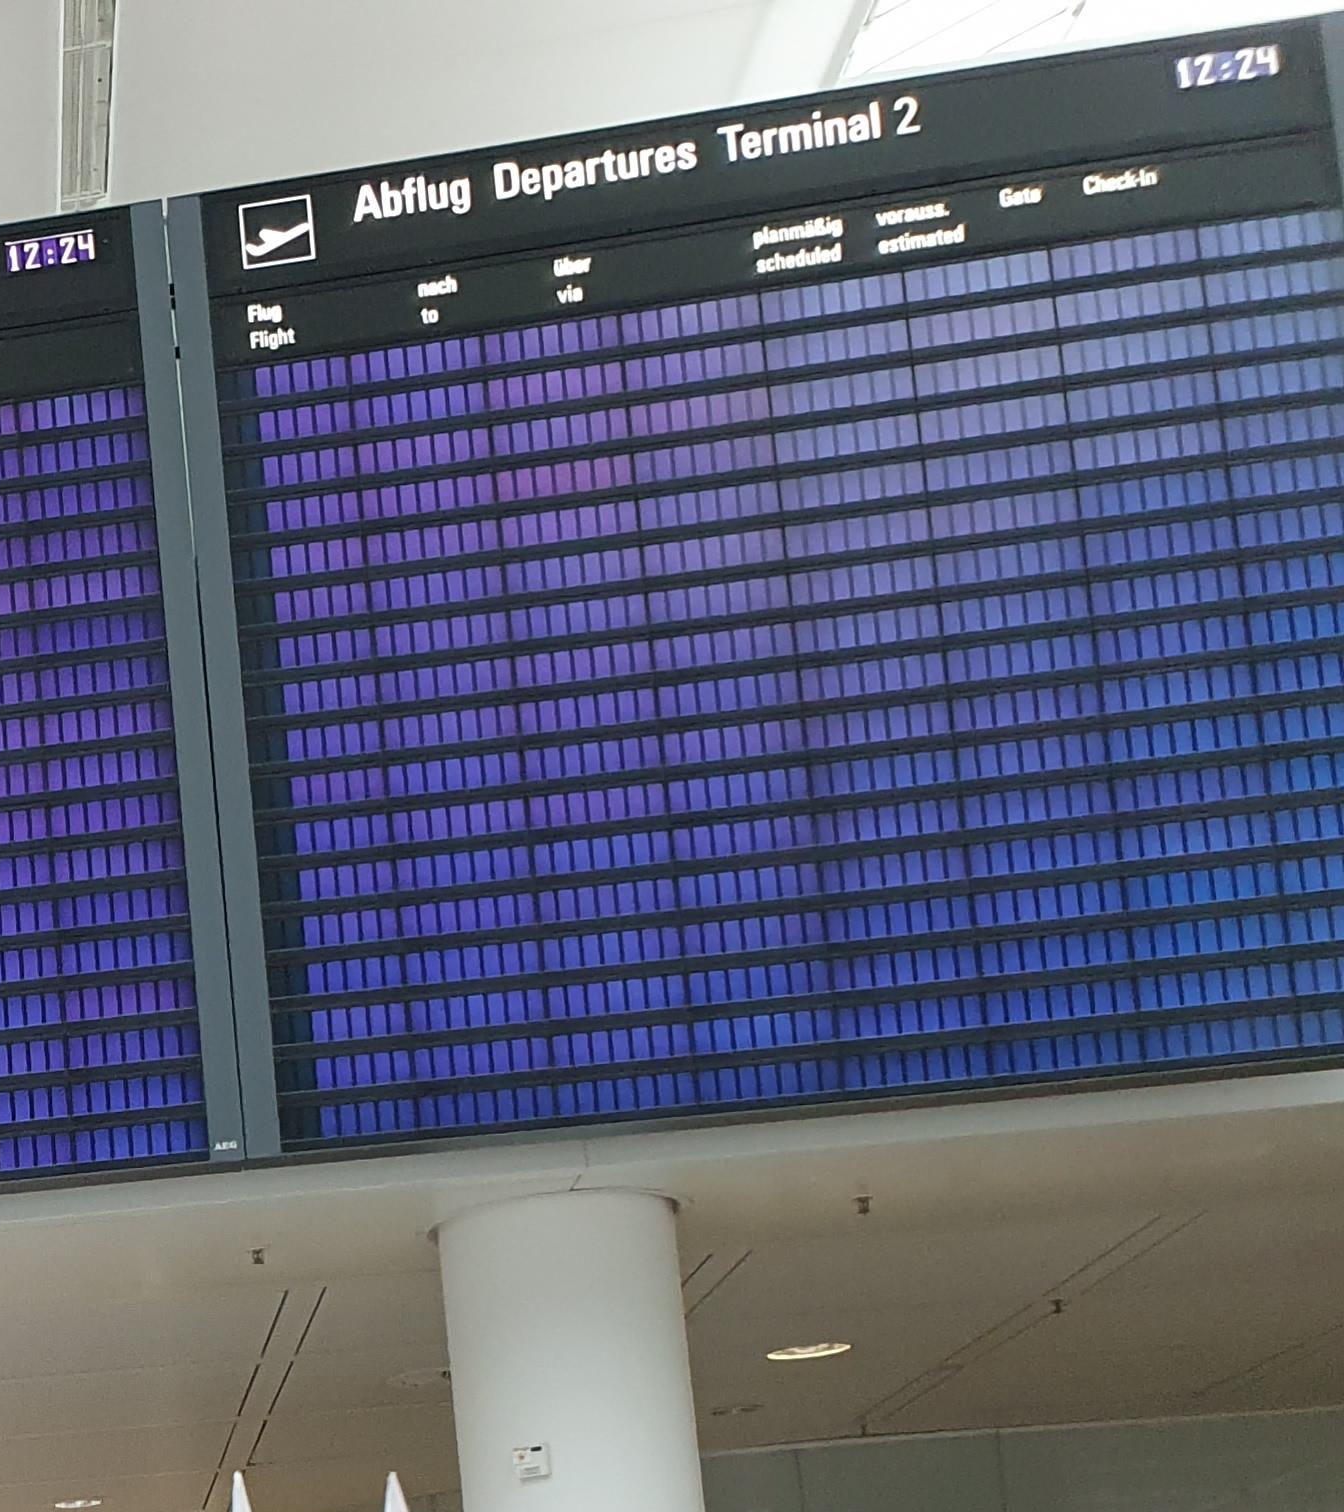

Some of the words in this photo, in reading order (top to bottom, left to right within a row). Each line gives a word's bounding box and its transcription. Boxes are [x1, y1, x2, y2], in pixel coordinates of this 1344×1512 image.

[1178, 46, 1279, 88] 12:24
[354, 176, 470, 222] Abflug
[494, 143, 697, 200] Departures
[717, 102, 881, 161] Terminal
[894, 96, 921, 134] 2
[8, 234, 94, 271] 12:24
[756, 243, 841, 273] scheduled
[557, 285, 583, 303] via
[248, 304, 282, 322] Flug
[421, 309, 438, 323] to
[250, 328, 295, 349] Flight
[215, 1140, 237, 1151] AEG
